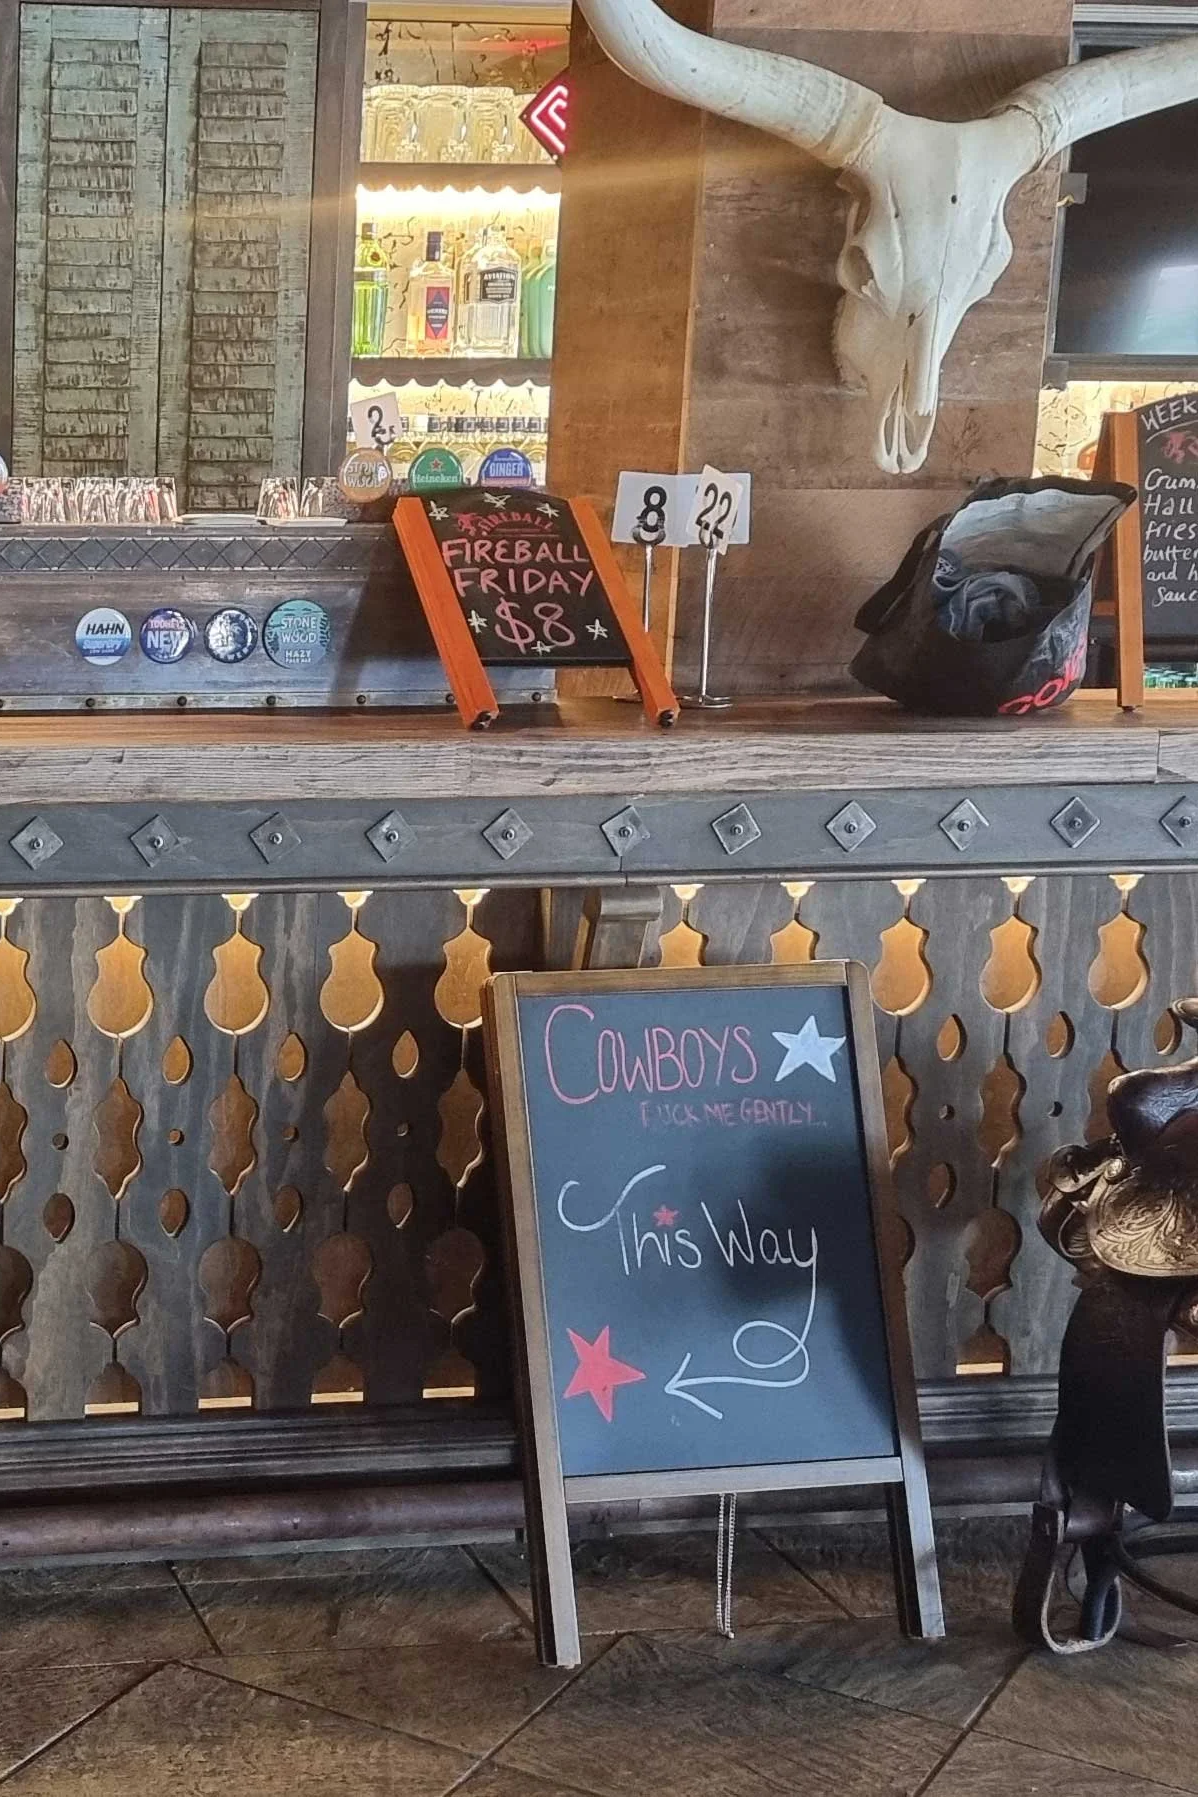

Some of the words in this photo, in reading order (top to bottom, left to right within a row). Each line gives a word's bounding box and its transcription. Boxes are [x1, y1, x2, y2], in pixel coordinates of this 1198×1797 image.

[414, 473, 459, 484] Heineken
[489, 461, 524, 477] GINGER
[640, 485, 667, 533] 8
[695, 482, 733, 539] 22
[441, 538, 590, 567] FIREBALL
[453, 567, 593, 598] FRIDAY
[1146, 561, 1178, 581] and
[86, 623, 125, 635] HAHN
[281, 616, 316, 630] STONE
[494, 597, 576, 655] $8
[147, 630, 189, 656] NEW
[281, 632, 317, 643] WOOD
[285, 649, 312, 658] HAZY
[544, 1003, 758, 1105] COWBOYS
[705, 1102, 737, 1126] ME
[557, 1163, 702, 1276] This
[701, 1198, 818, 1300] Way
